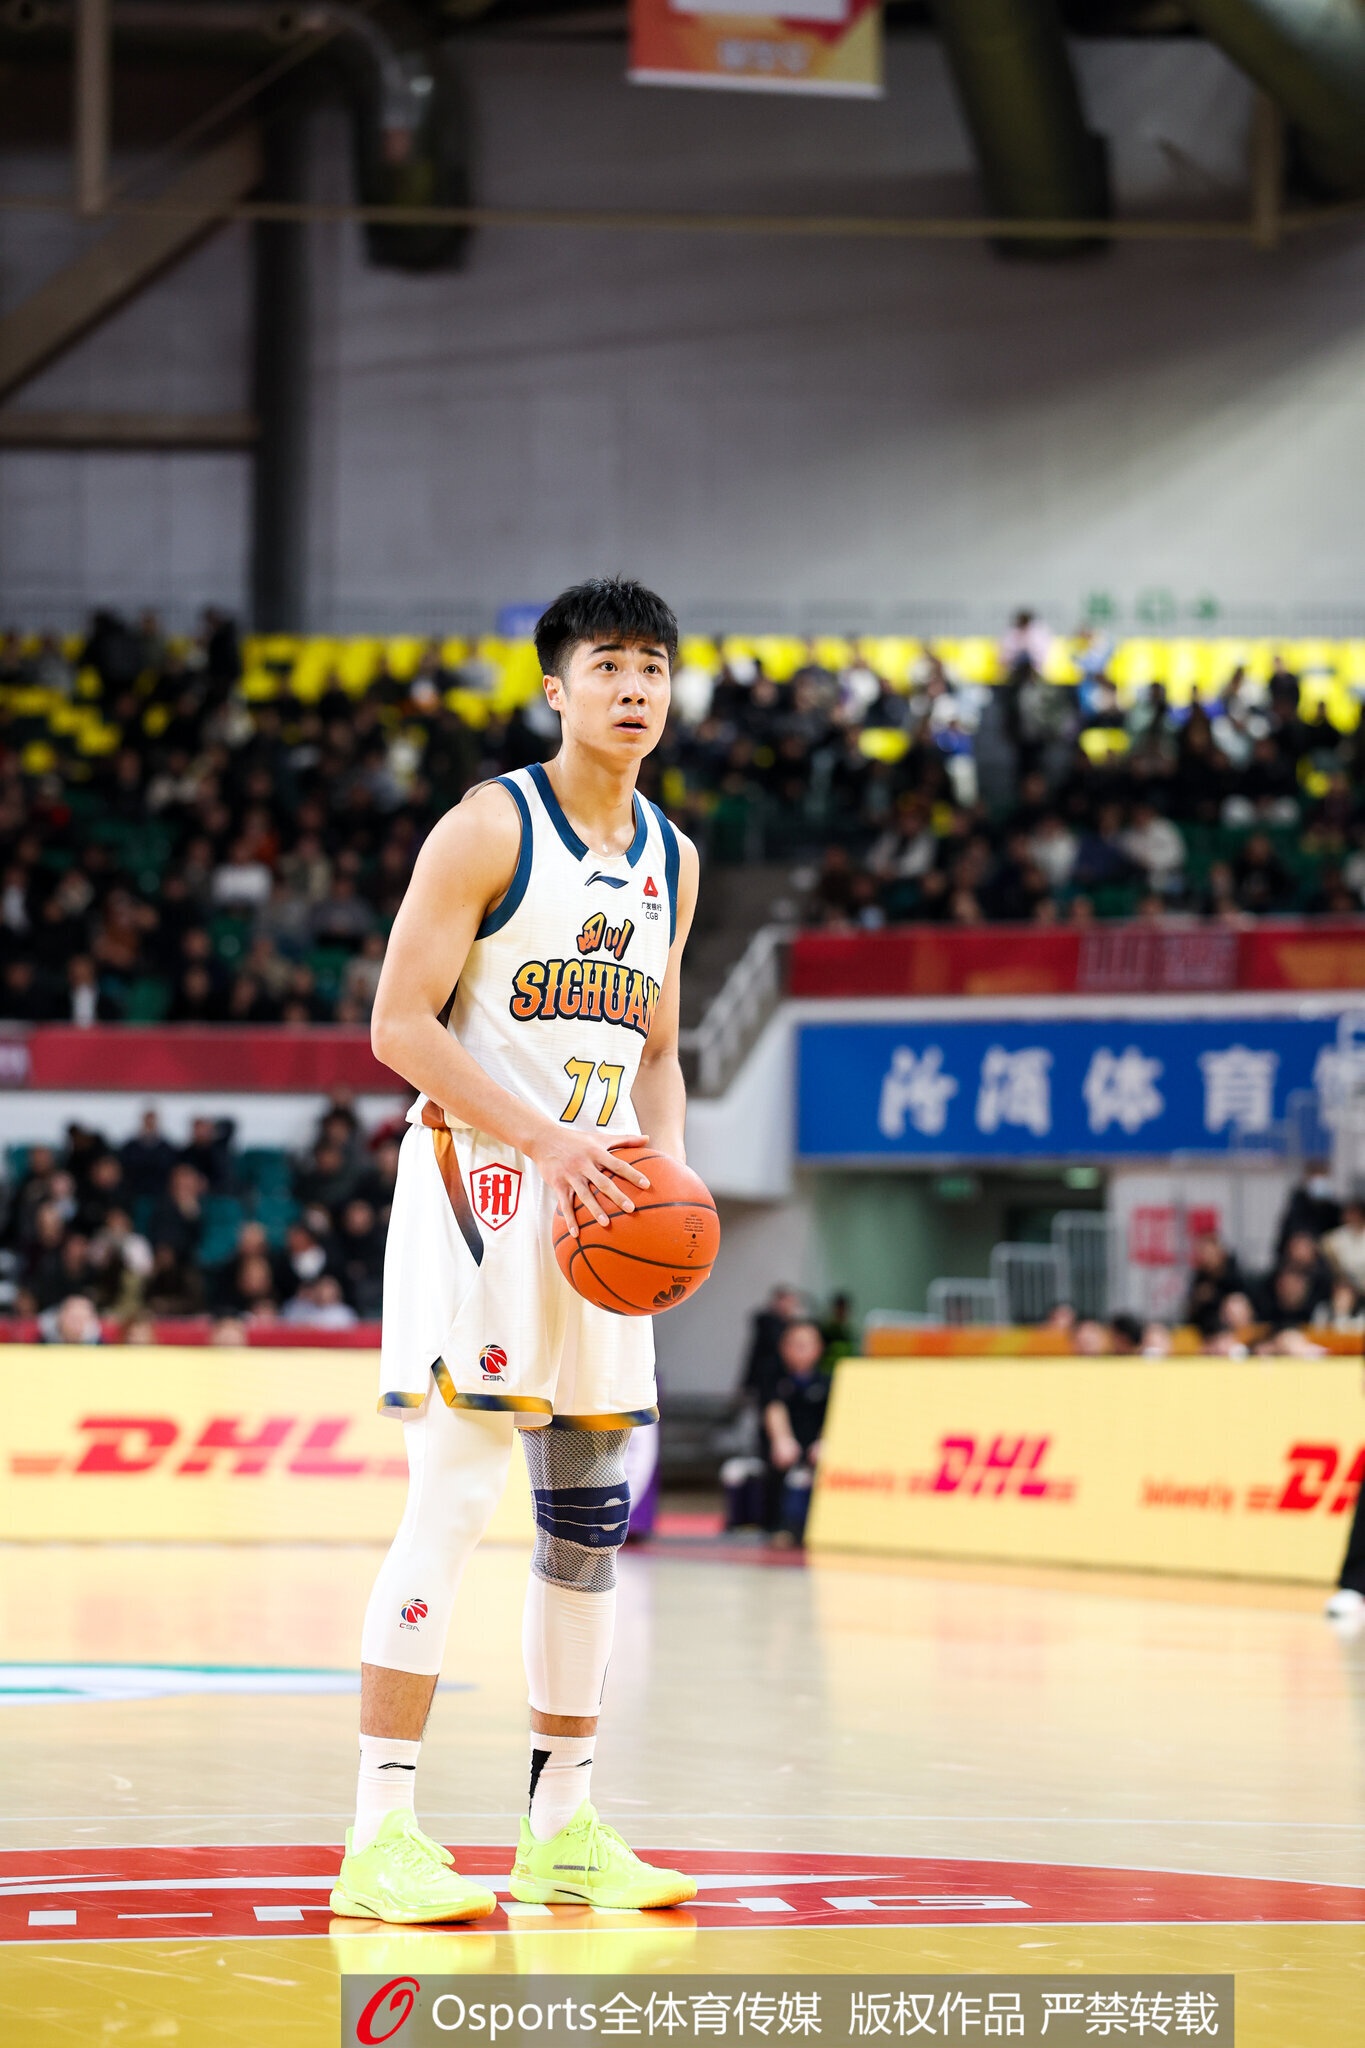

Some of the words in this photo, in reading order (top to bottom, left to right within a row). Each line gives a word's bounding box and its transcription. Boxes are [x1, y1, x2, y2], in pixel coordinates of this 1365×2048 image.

[576, 912, 635, 961] 四川
[645, 911, 659, 921] CGB
[559, 1057, 625, 1127] 77
[482, 1374, 505, 1382] CBA
[74, 1415, 366, 1475] DHL
[931, 1433, 1052, 1499] DHL
[399, 1622, 421, 1633] CBA
